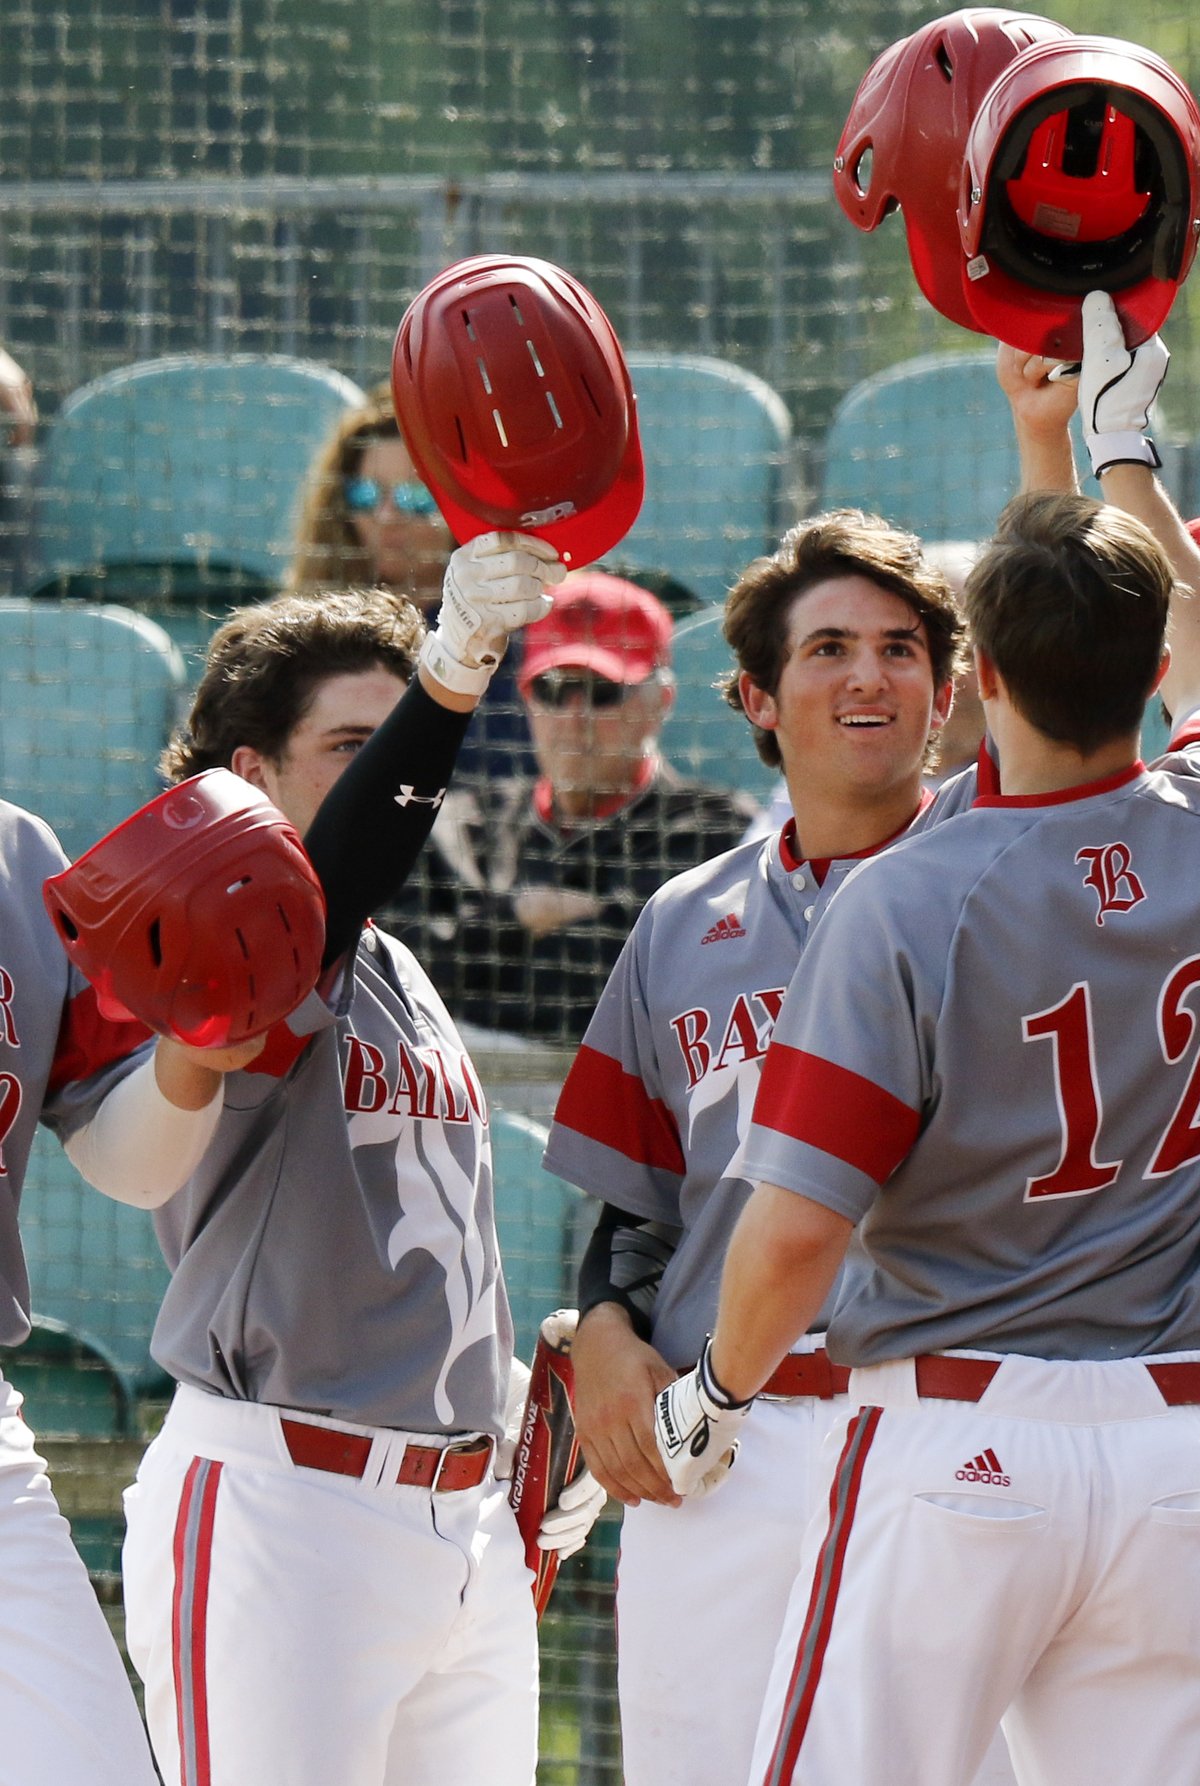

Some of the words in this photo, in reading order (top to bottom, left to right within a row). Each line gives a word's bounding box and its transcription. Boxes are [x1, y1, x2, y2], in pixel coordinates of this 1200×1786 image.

[1075, 841, 1147, 927] B
[701, 926, 746, 946] adidas
[660, 1390, 680, 1449] Franklin
[955, 1468, 1011, 1487] adidas
